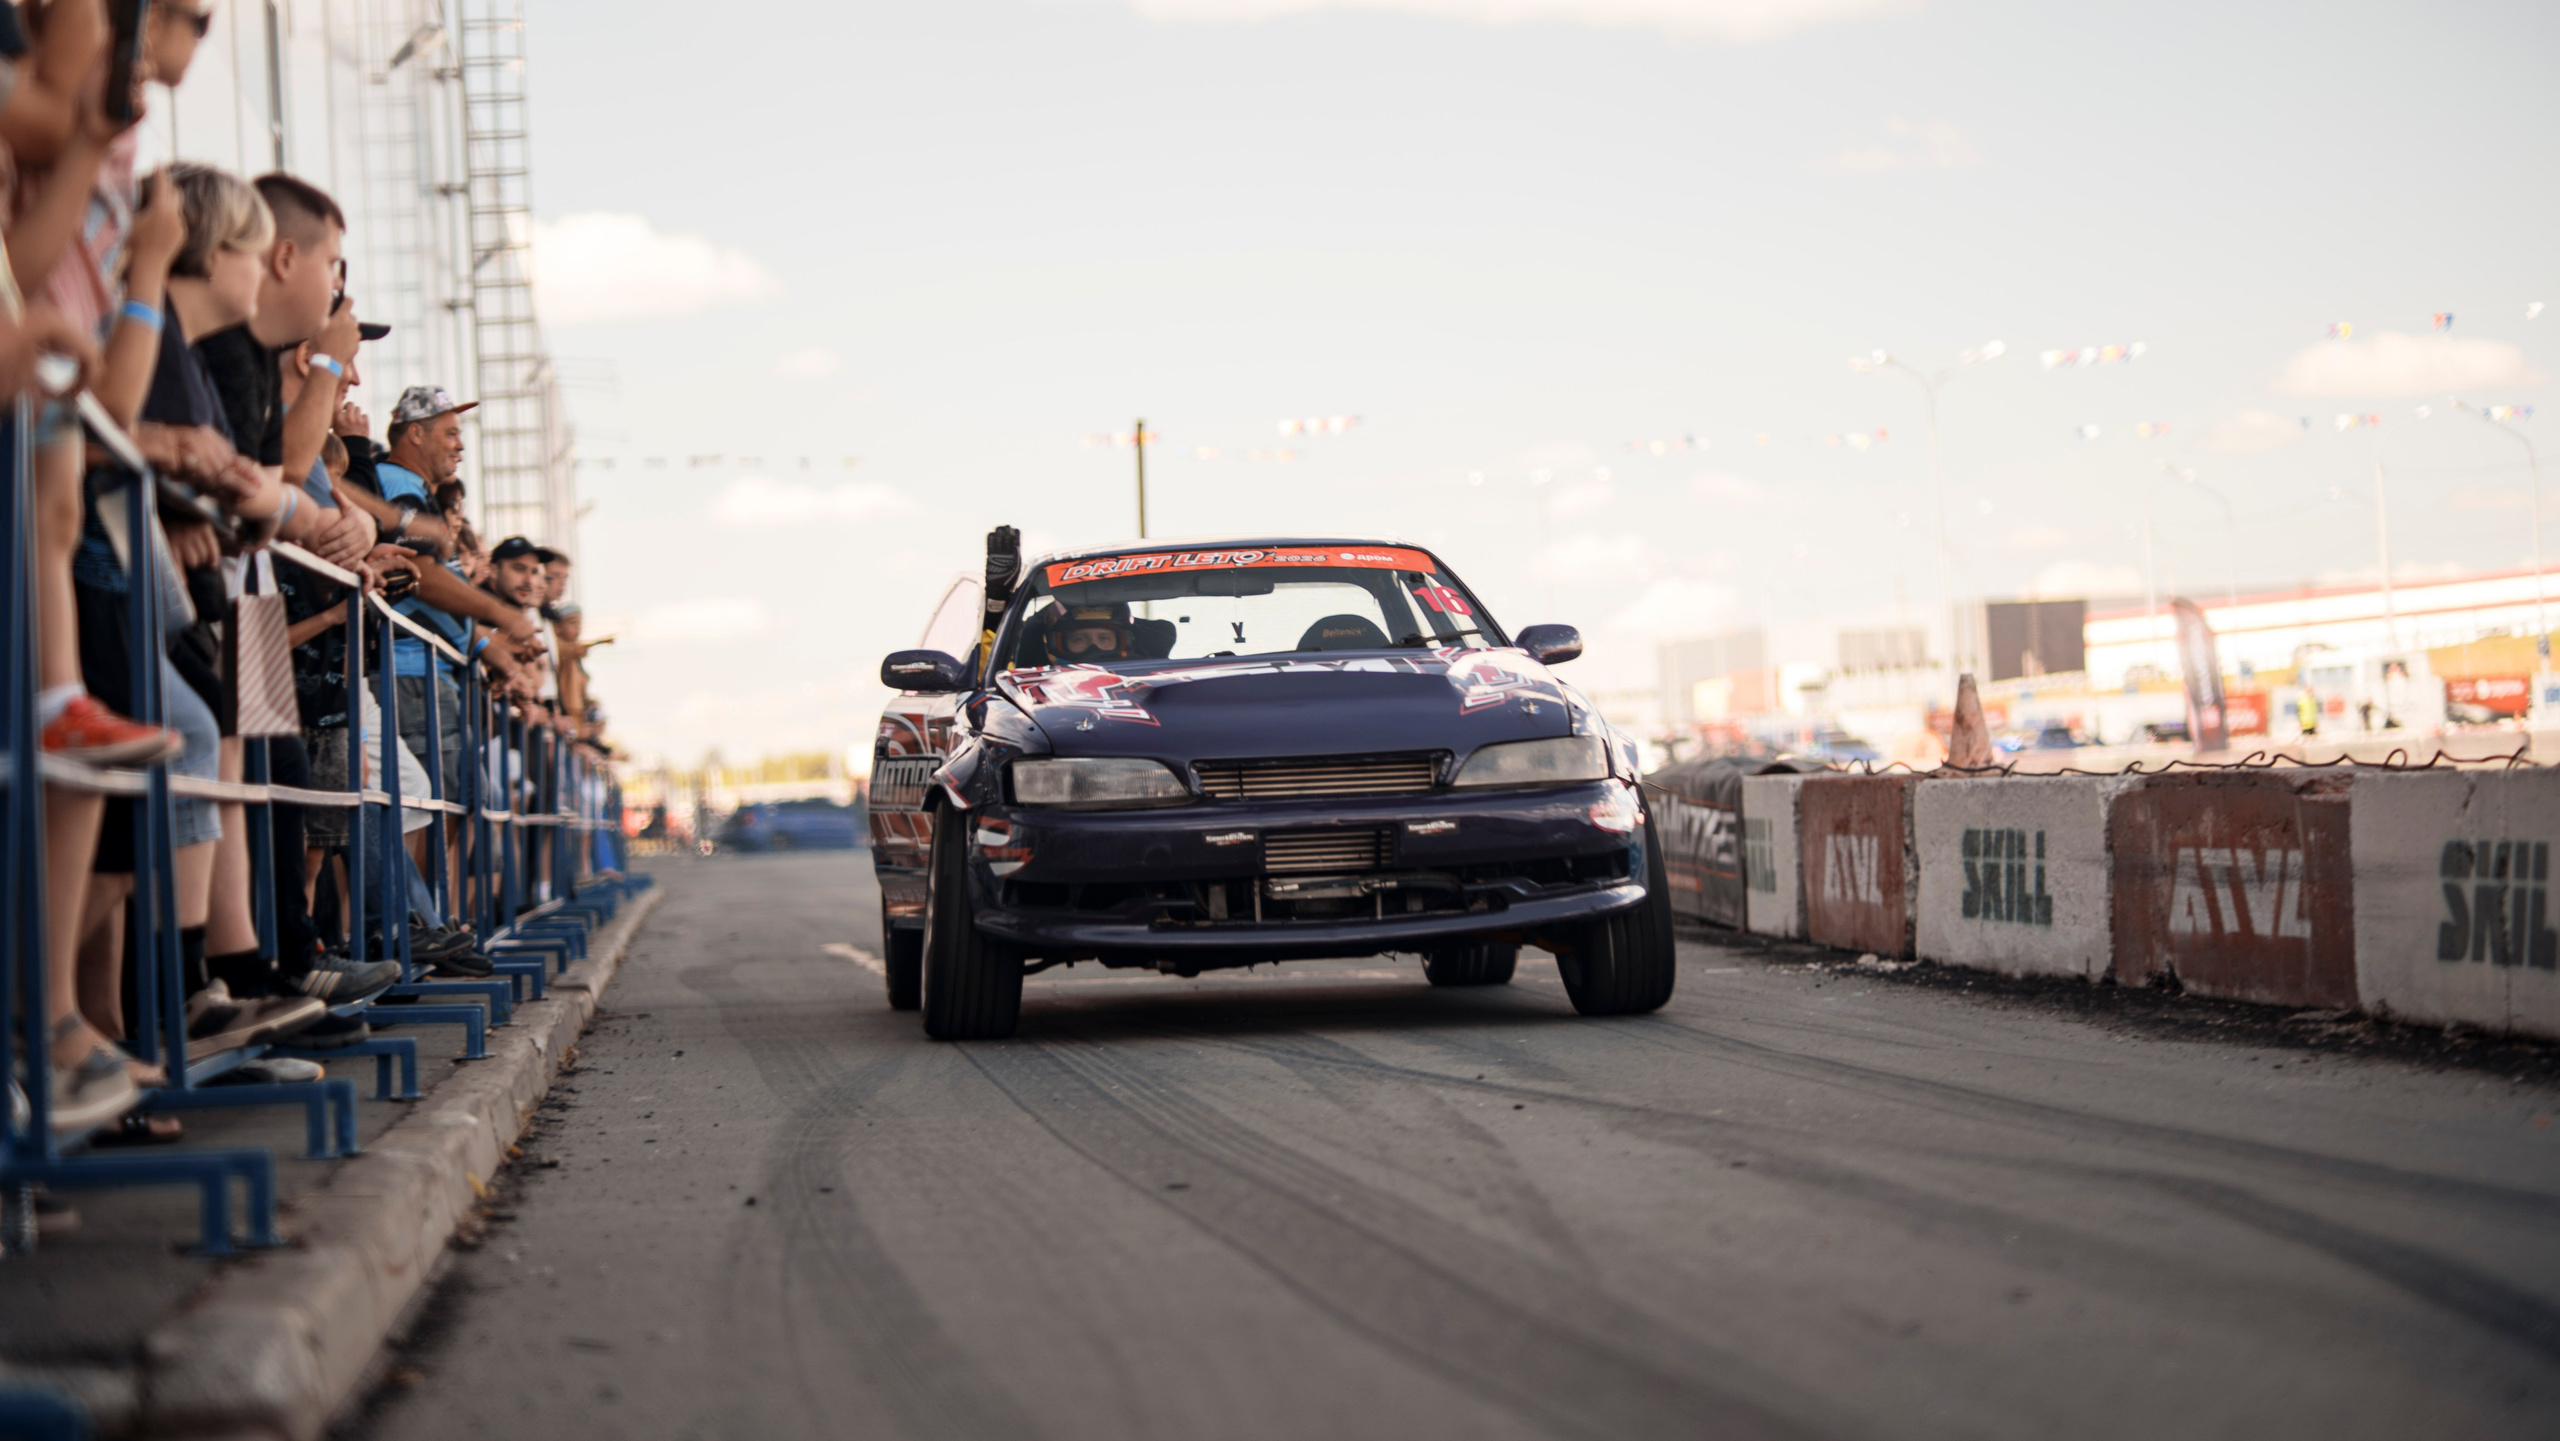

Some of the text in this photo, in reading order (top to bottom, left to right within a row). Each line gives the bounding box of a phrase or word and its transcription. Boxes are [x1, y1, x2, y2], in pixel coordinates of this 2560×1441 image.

[1062, 554, 1173, 581] DRIFT
[1173, 550, 1265, 567] LETO
[1412, 586, 1473, 616] 16
[1962, 827, 2053, 926] SKILL
[2168, 847, 2312, 939] ATVL
[2437, 840, 2560, 971] SKIL
